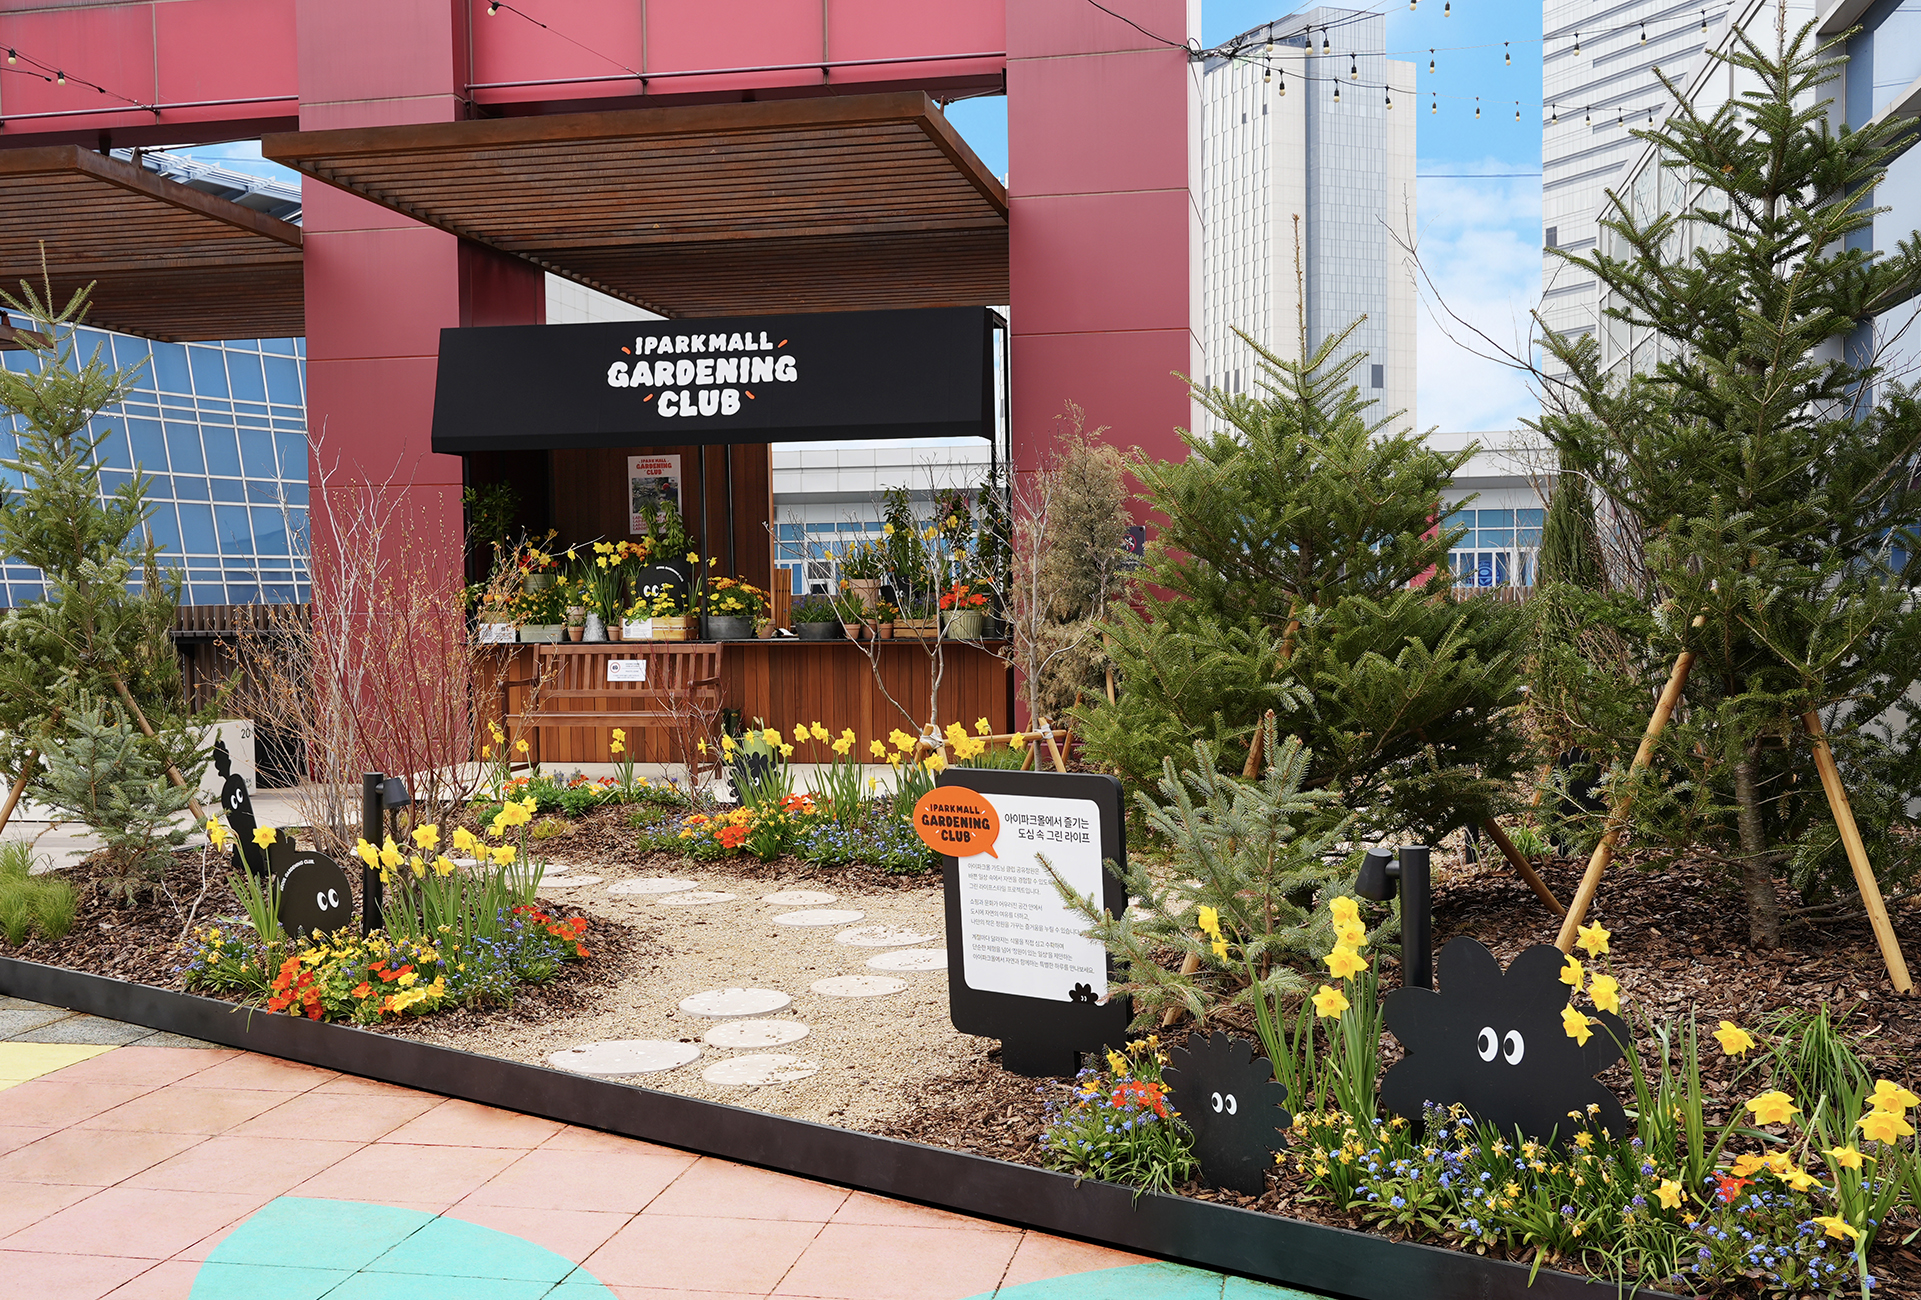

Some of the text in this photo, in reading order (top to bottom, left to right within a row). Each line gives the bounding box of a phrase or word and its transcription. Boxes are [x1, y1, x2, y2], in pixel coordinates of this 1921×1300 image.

[635, 332, 773, 355] IPARKMALL
[607, 355, 798, 388] GARDENING
[658, 388, 740, 417] CLUB
[240, 728, 250, 739] 20
[930, 804, 980, 814] IPARKMALL
[922, 814, 990, 830] GARDENING
[1004, 813, 1089, 829] 아이파크몰에서 즐기는
[941, 829, 970, 843] CLUB
[1018, 828, 1090, 843] 도심 속 그린 라이프
[979, 884, 1006, 892] 라이프스타일
[973, 954, 1005, 963] 아이파크몰에서
